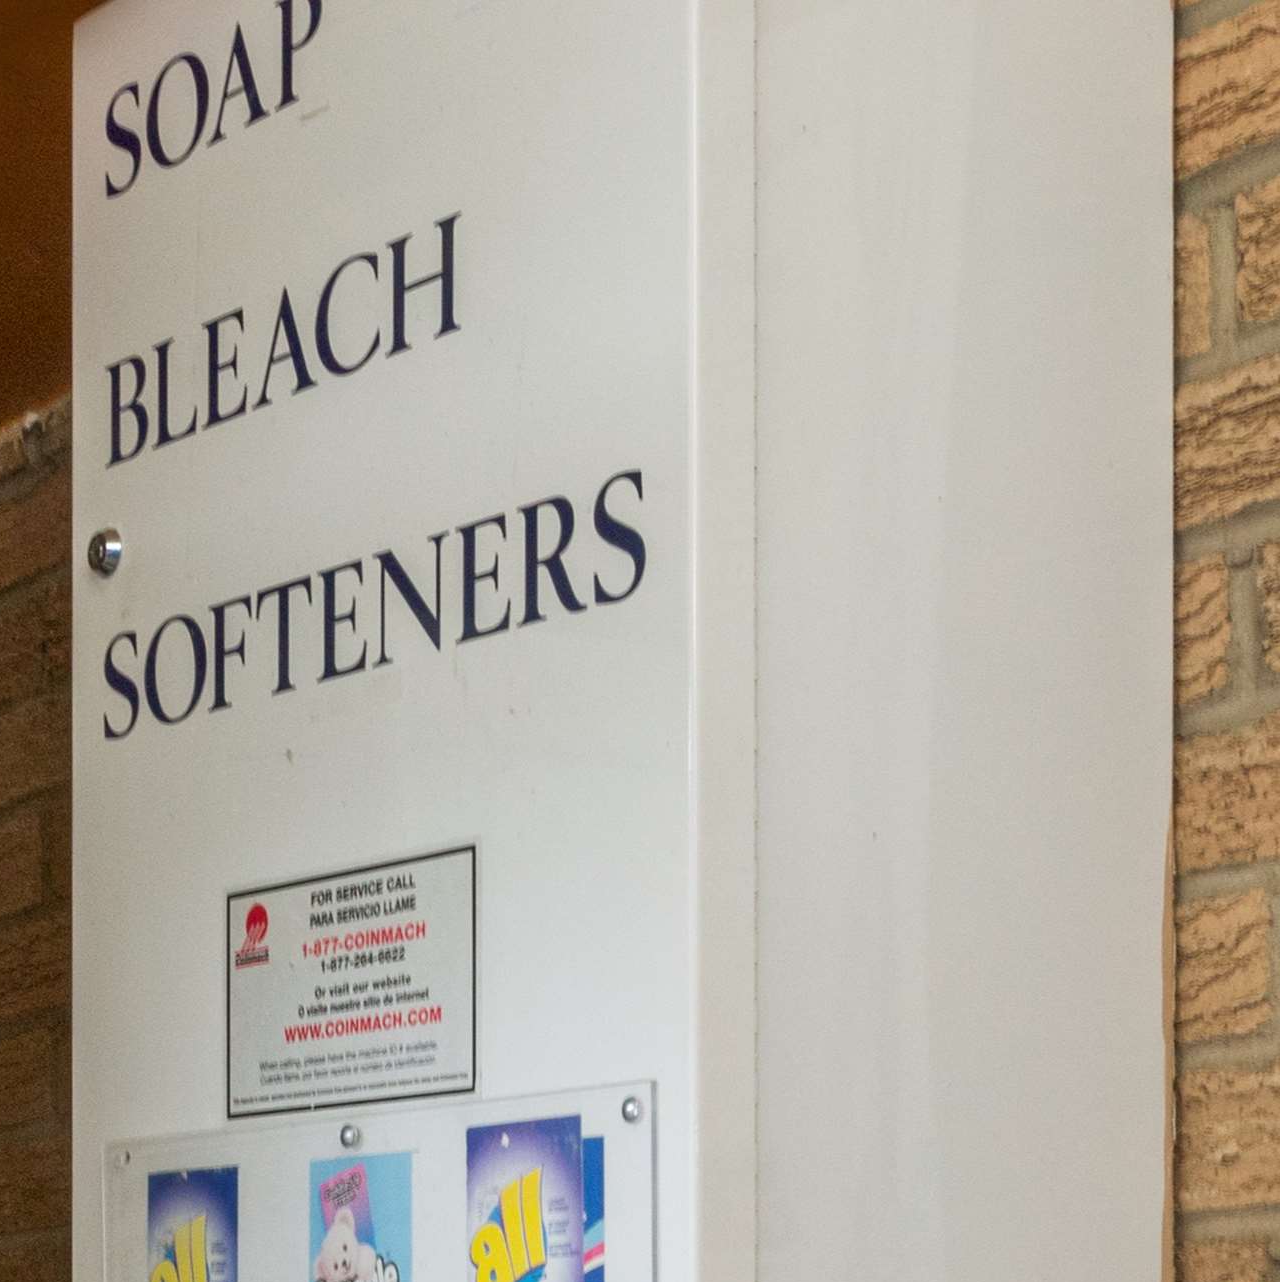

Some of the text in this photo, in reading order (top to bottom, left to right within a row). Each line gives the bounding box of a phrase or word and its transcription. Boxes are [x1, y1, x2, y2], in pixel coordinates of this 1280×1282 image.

[104, 0, 323, 197] SOAP
[104, 210, 462, 469] BLEACH
[102, 467, 648, 740] SOFTENERS
[310, 872, 416, 908] FOR SERVICE CALL
[309, 895, 417, 929] PARA SERVICIO LLAME
[301, 919, 427, 960] 1-877-COINMACH
[329, 982, 350, 998] visit
[352, 981, 369, 994] our
[372, 974, 412, 991] website
[283, 1005, 443, 1045] WWW.COINMACH.COM
